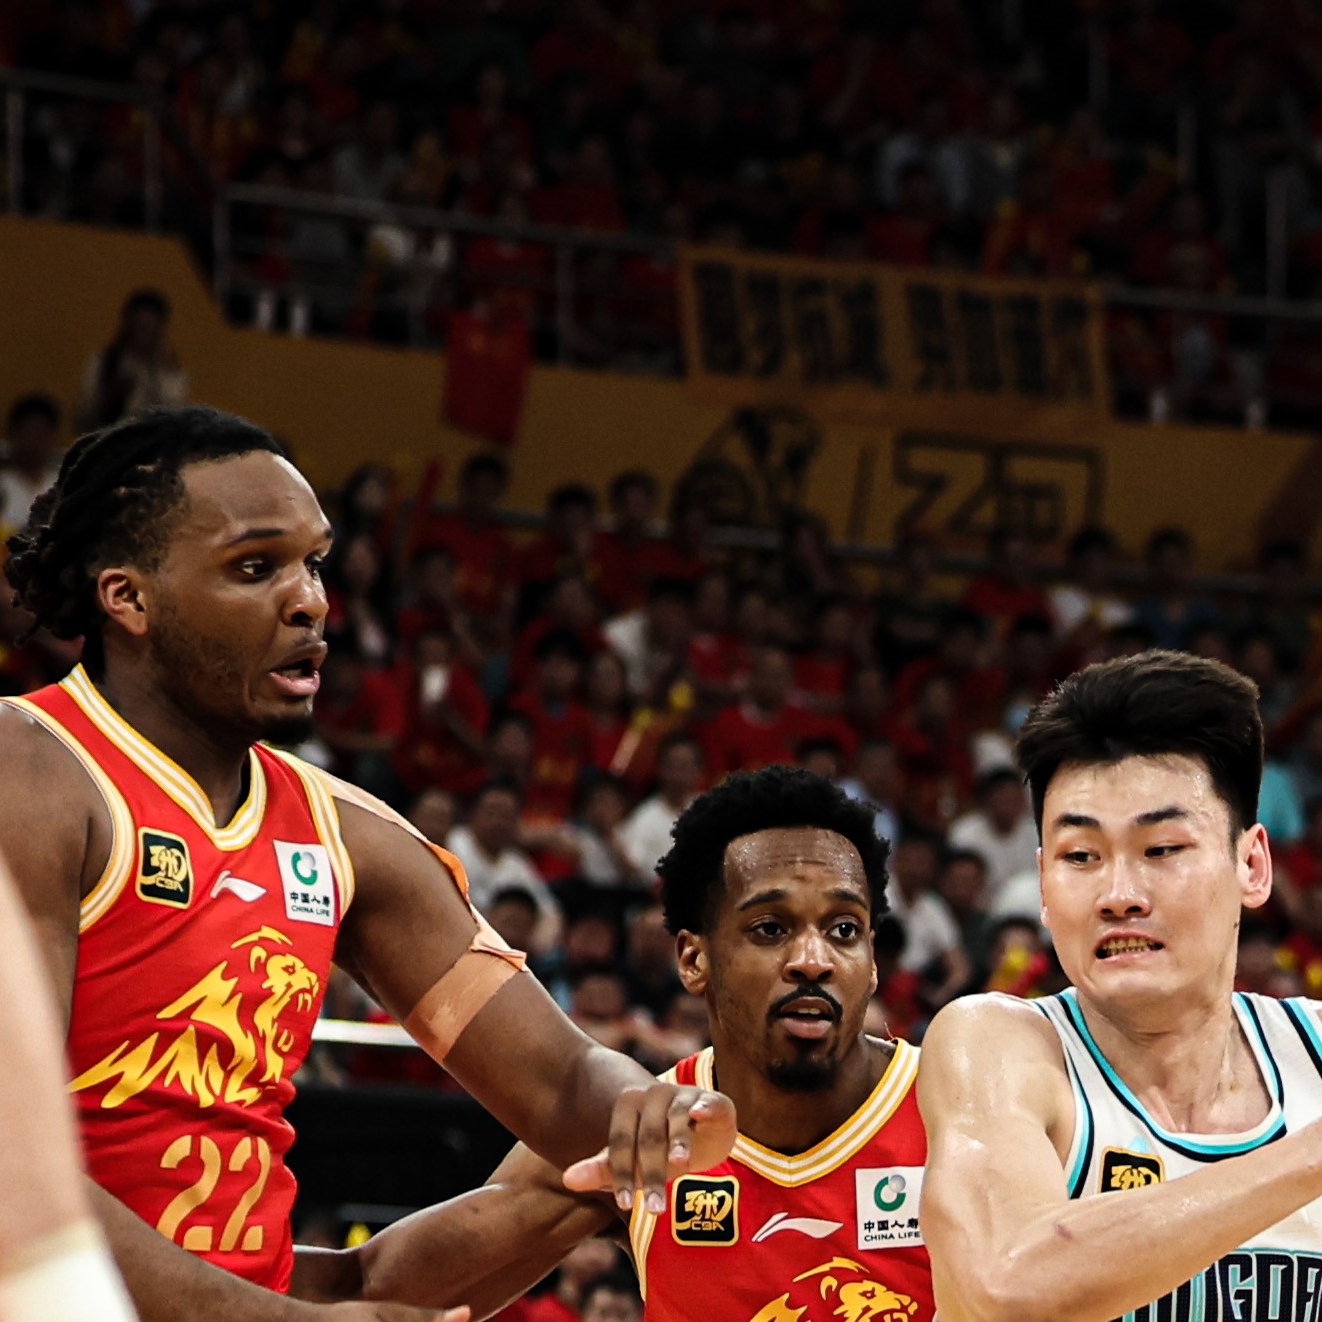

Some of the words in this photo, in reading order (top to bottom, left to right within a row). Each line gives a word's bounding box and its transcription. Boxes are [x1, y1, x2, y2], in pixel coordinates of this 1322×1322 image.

[156, 1134, 271, 1251] 22
[690, 1220, 725, 1231] CBA
[864, 1218, 919, 1233] 中国人寿
[864, 1234, 895, 1242] CHINA
[898, 1231, 920, 1240] LIFE
